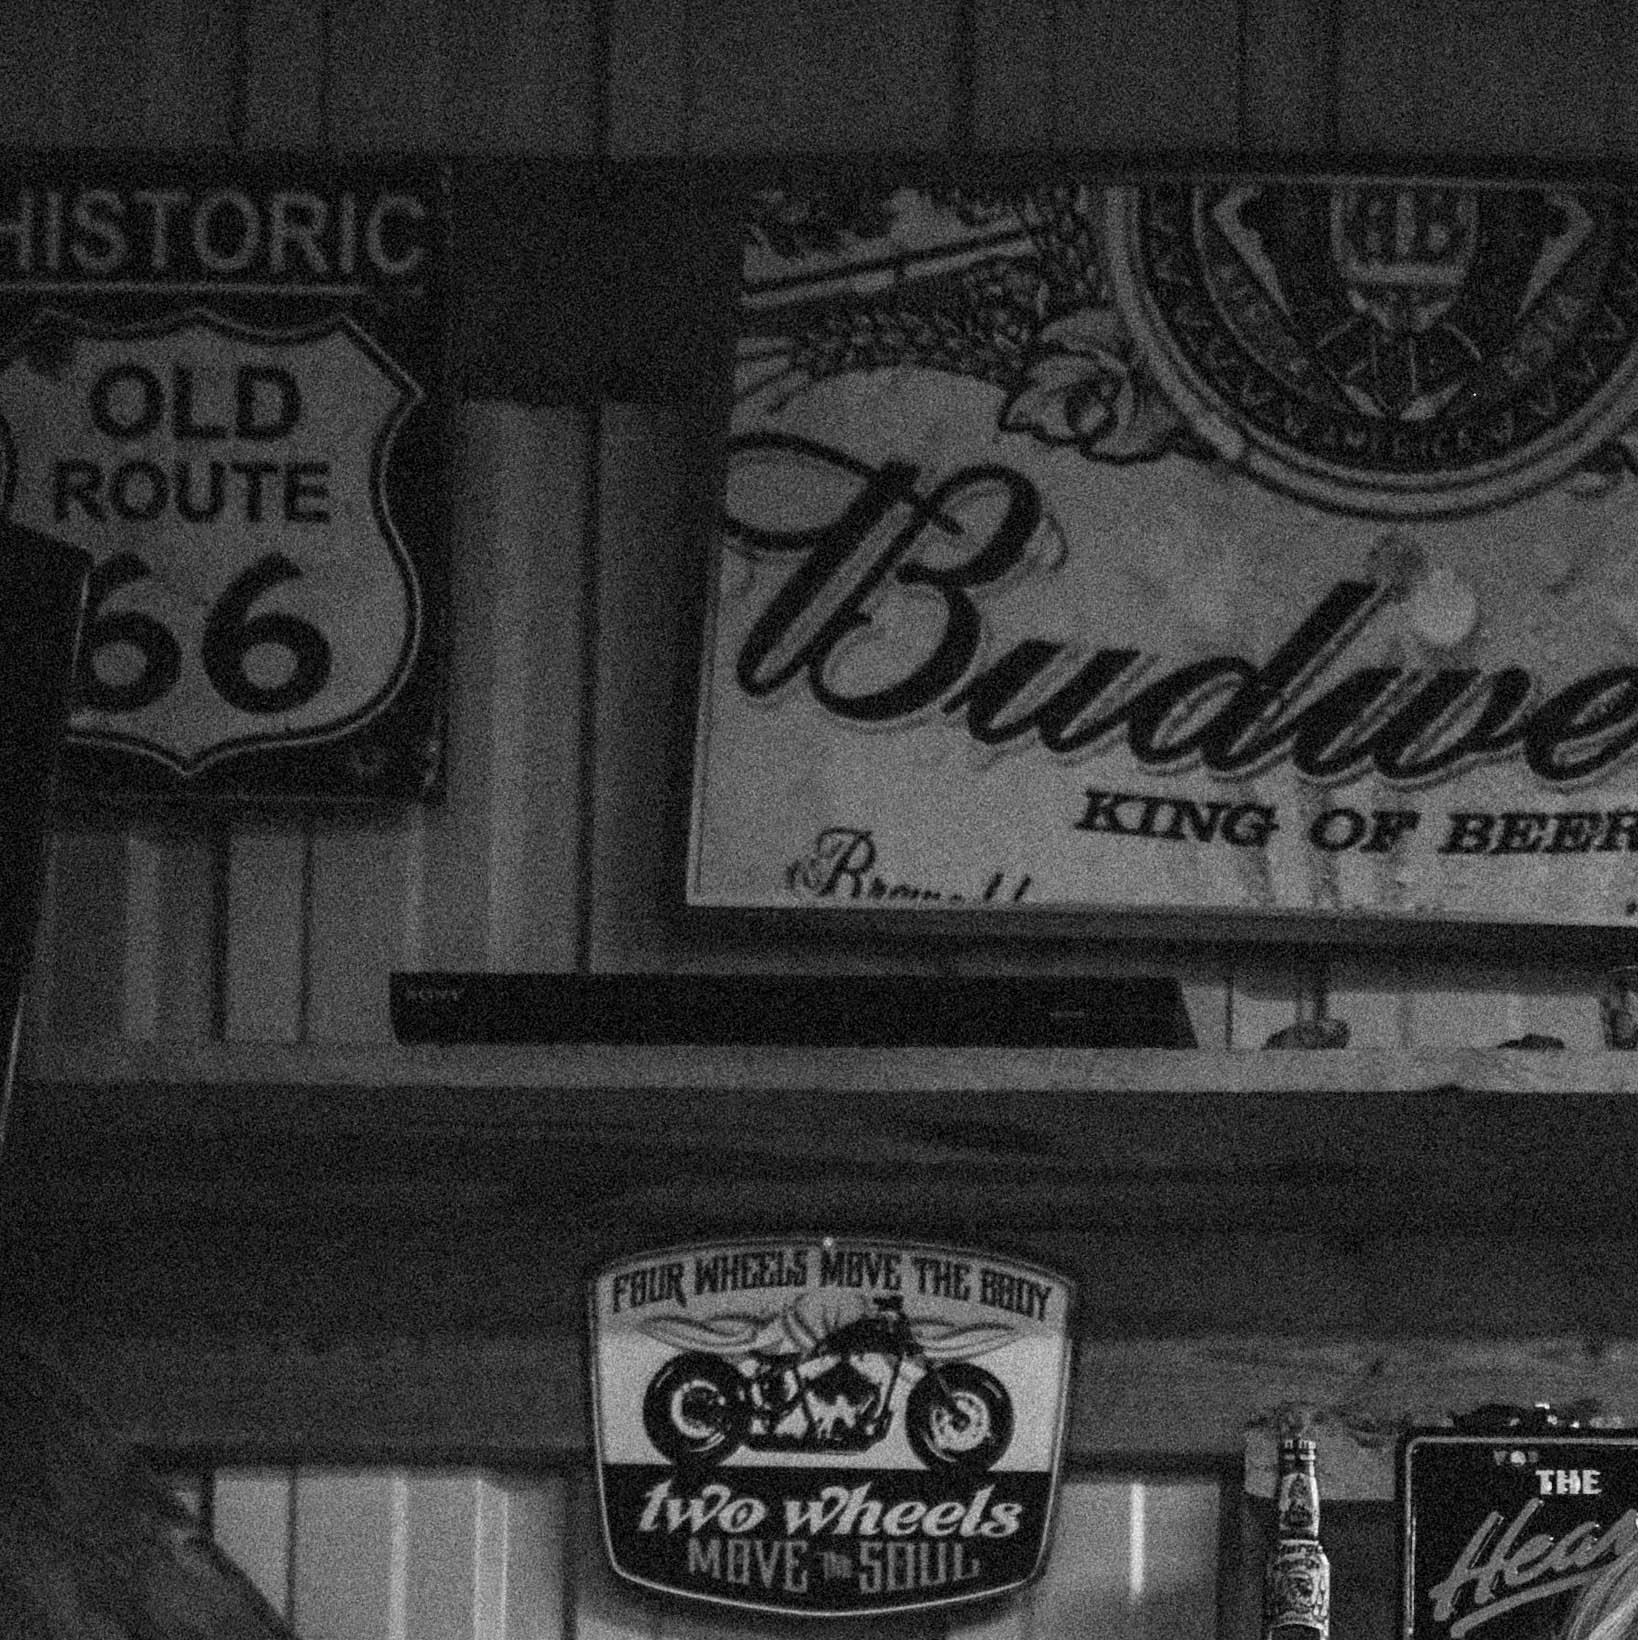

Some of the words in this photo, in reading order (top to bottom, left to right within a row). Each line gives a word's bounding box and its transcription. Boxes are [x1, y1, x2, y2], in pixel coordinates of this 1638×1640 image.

[0, 187, 427, 276] HISTORIC
[89, 362, 303, 441] OLD
[52, 459, 331, 525] ROUTE
[82, 551, 332, 716] 66
[1075, 789, 1278, 850] KING
[1308, 808, 1418, 854] OF
[611, 1262, 687, 1315] FOUR
[693, 1247, 810, 1296] WHEELS
[818, 1245, 903, 1291] MOVE
[912, 1256, 973, 1303] THE
[978, 1268, 1055, 1323] BODY
[635, 1478, 768, 1534] two
[784, 1480, 1024, 1539] wheels
[1534, 1468, 1603, 1496] THE
[686, 1538, 810, 1595] MOVE
[857, 1539, 982, 1596] SOUL
